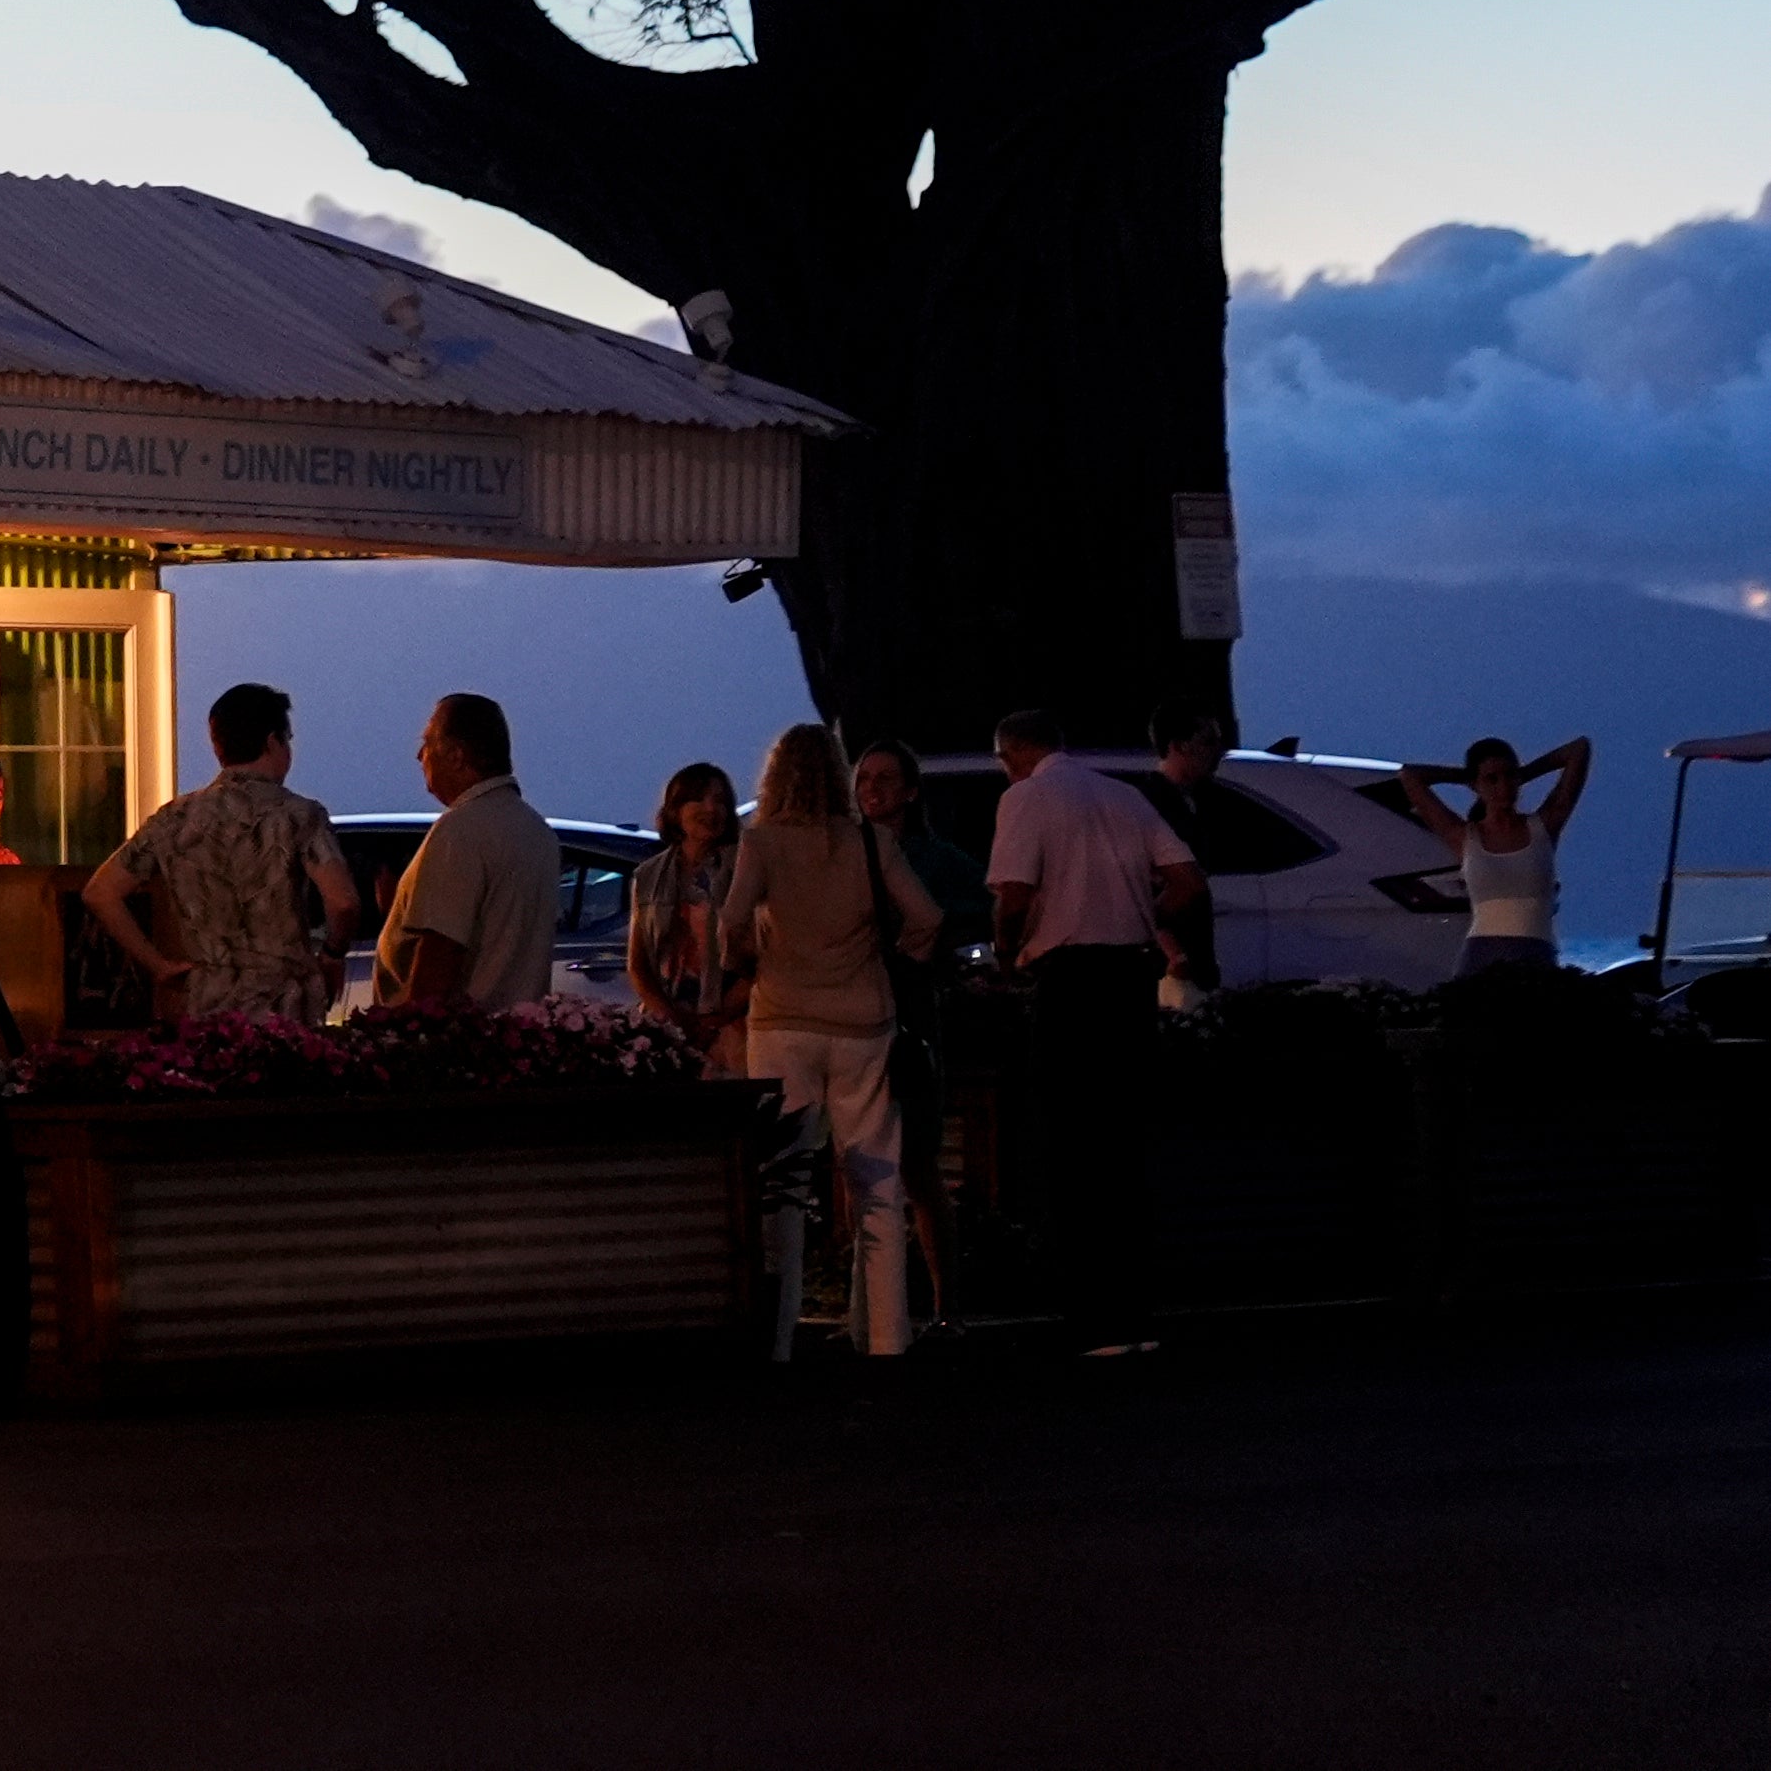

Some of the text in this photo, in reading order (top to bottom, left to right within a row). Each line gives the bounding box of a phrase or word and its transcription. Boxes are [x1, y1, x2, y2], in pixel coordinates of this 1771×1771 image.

[85, 432, 189, 478] DAILY
[221, 440, 356, 487] DINNER
[367, 448, 517, 496] NIGHTLY
